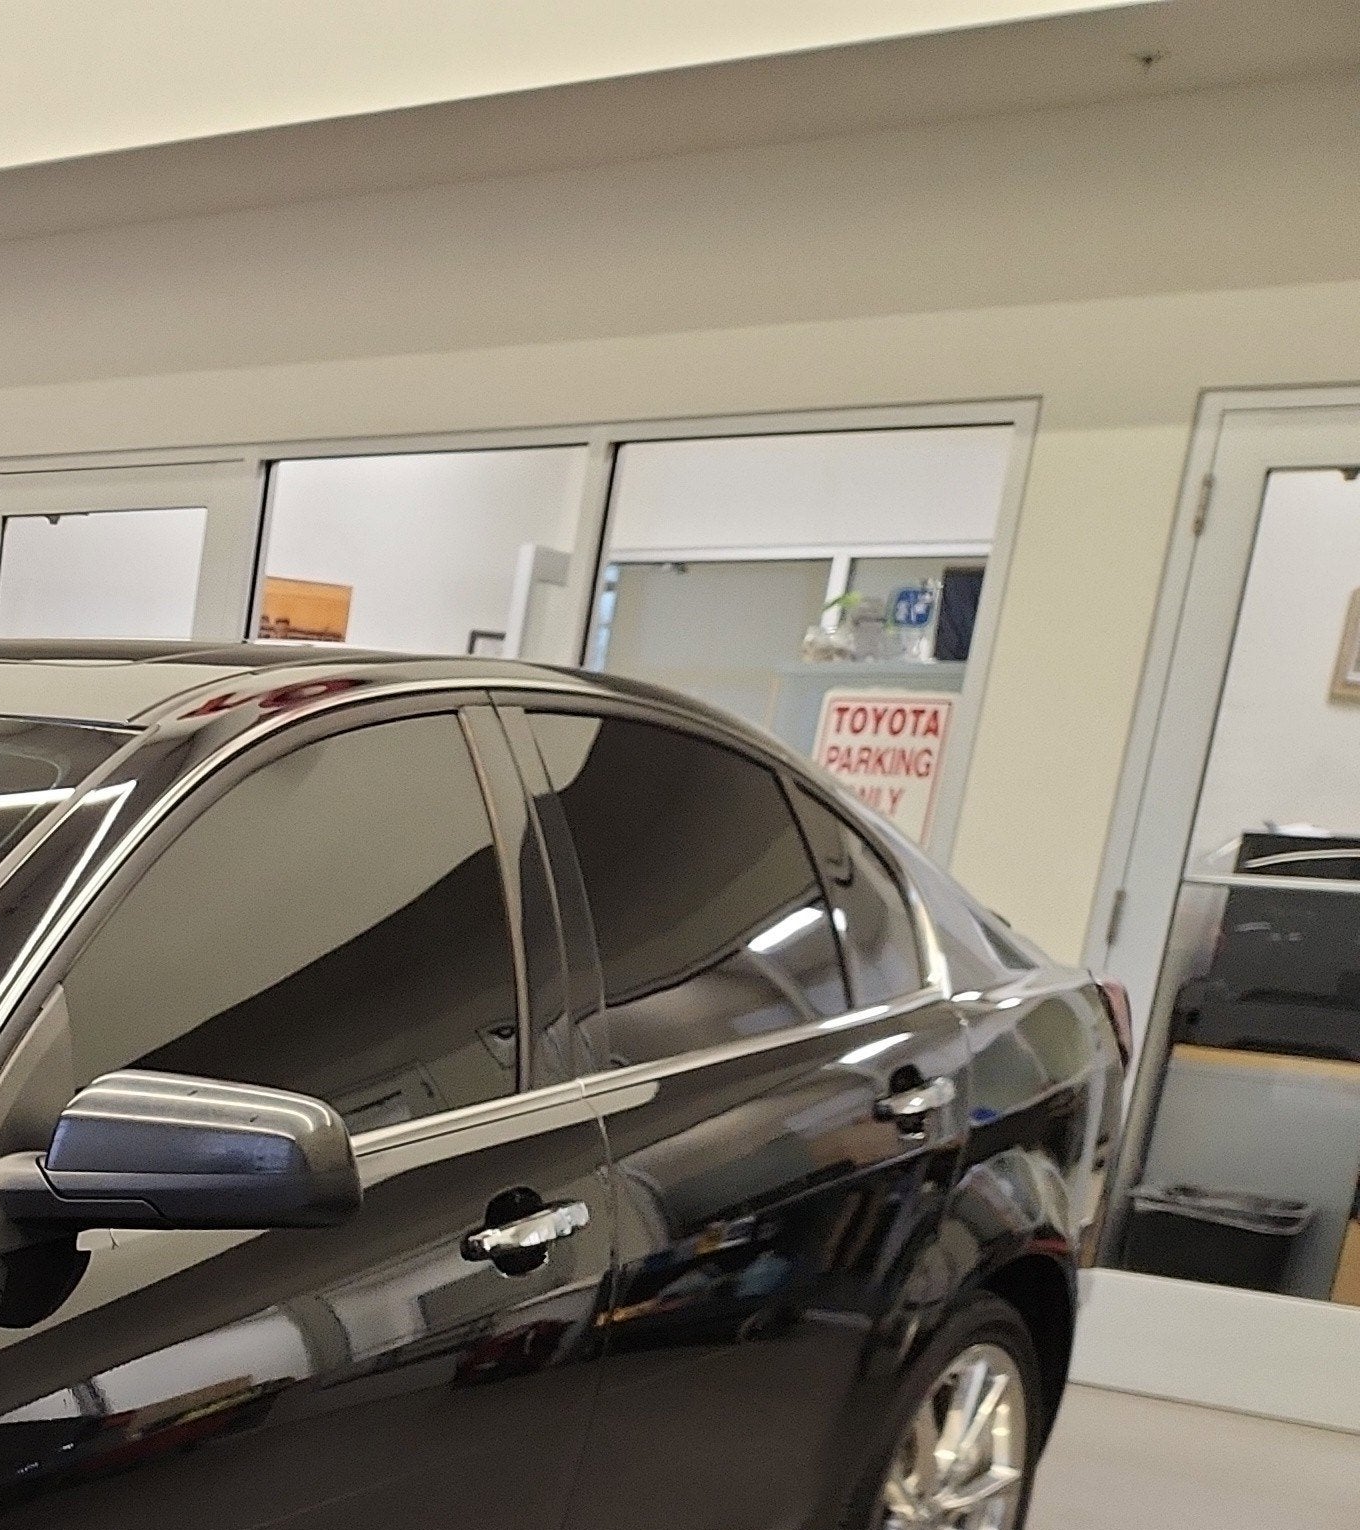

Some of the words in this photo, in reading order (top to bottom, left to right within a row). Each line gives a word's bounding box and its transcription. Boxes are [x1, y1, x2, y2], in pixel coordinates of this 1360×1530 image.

[833, 705, 940, 738] TOYOTA
[826, 745, 933, 778] PARKING
[853, 785, 905, 815] NLY
